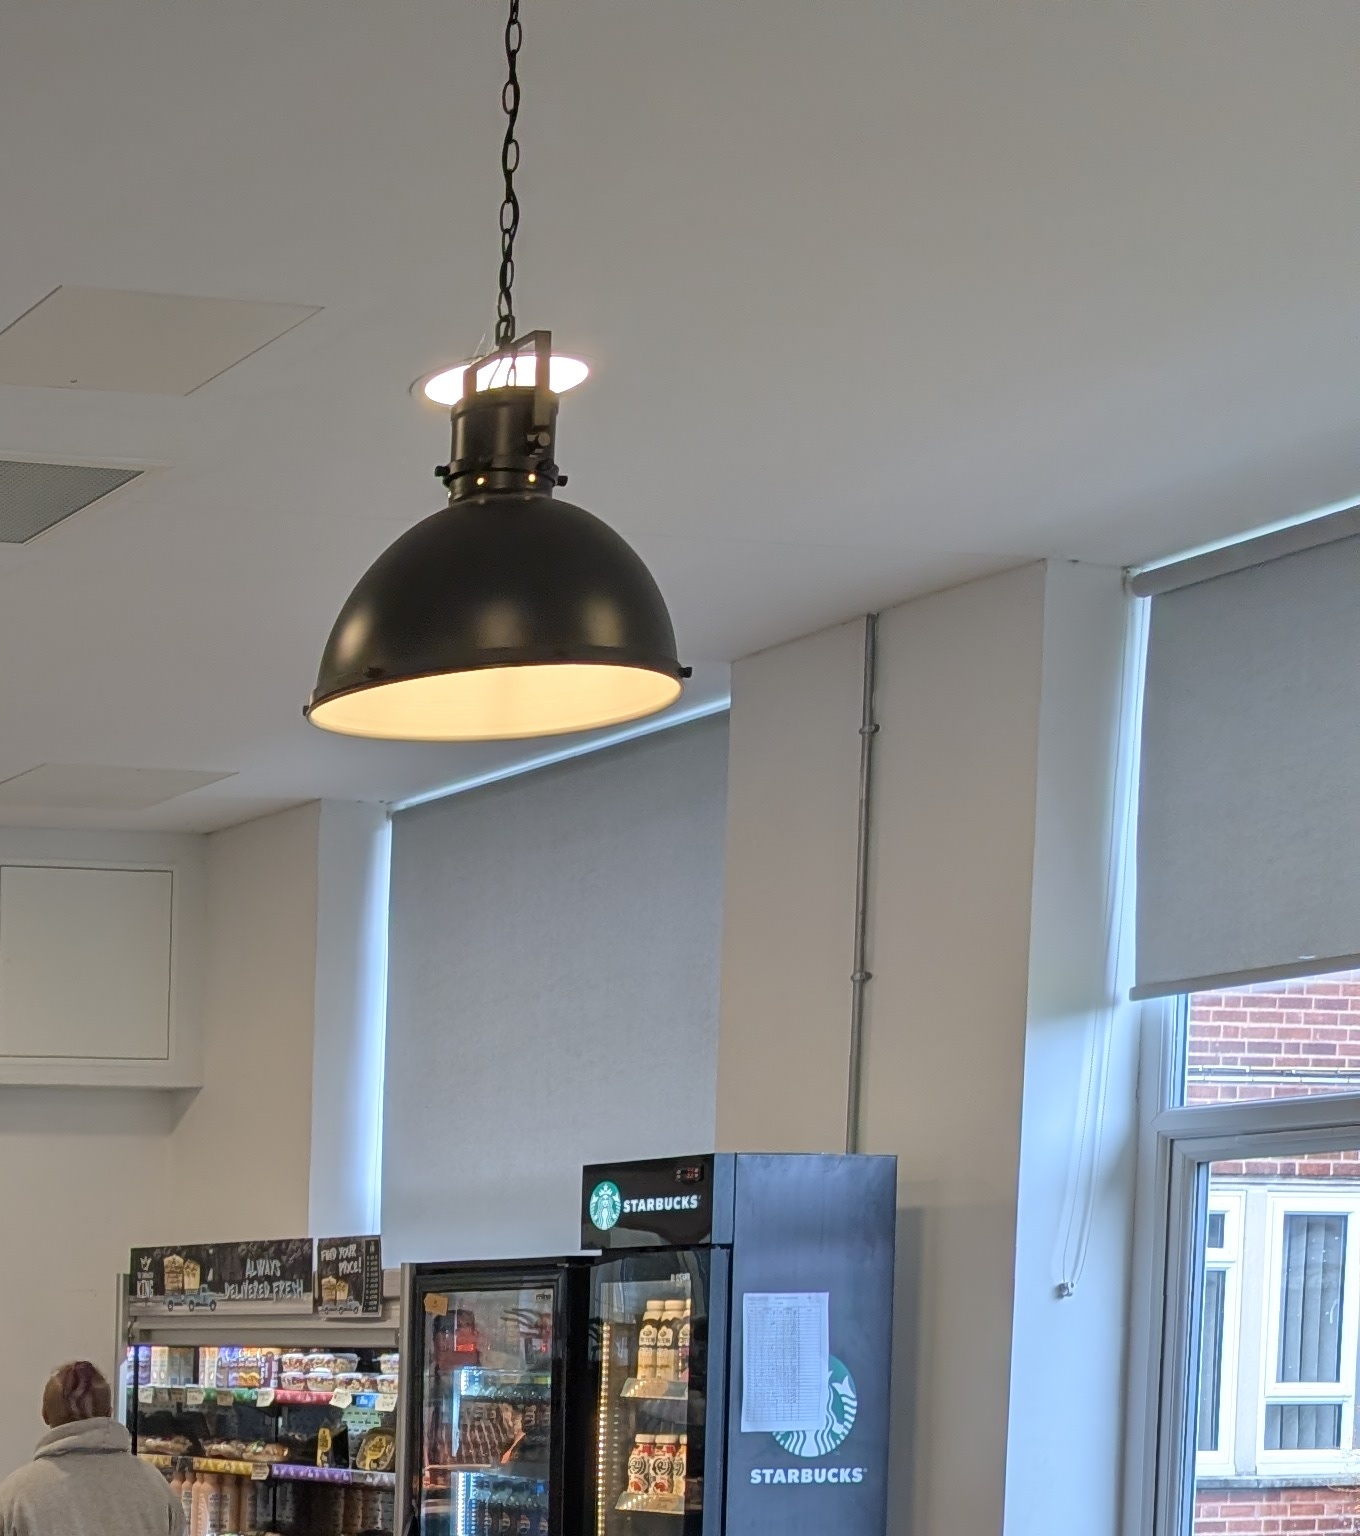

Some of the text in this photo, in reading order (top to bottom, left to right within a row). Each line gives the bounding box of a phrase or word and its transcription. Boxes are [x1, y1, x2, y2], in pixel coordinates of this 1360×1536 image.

[623, 1194, 699, 1213] STARBUCKS
[338, 1243, 357, 1260] YOUR
[245, 1258, 281, 1278] ALWAYS
[338, 1256, 362, 1277] PRICE!
[224, 1279, 305, 1302] DELIVERED FRESH
[750, 1467, 864, 1484] STARBUCKS
